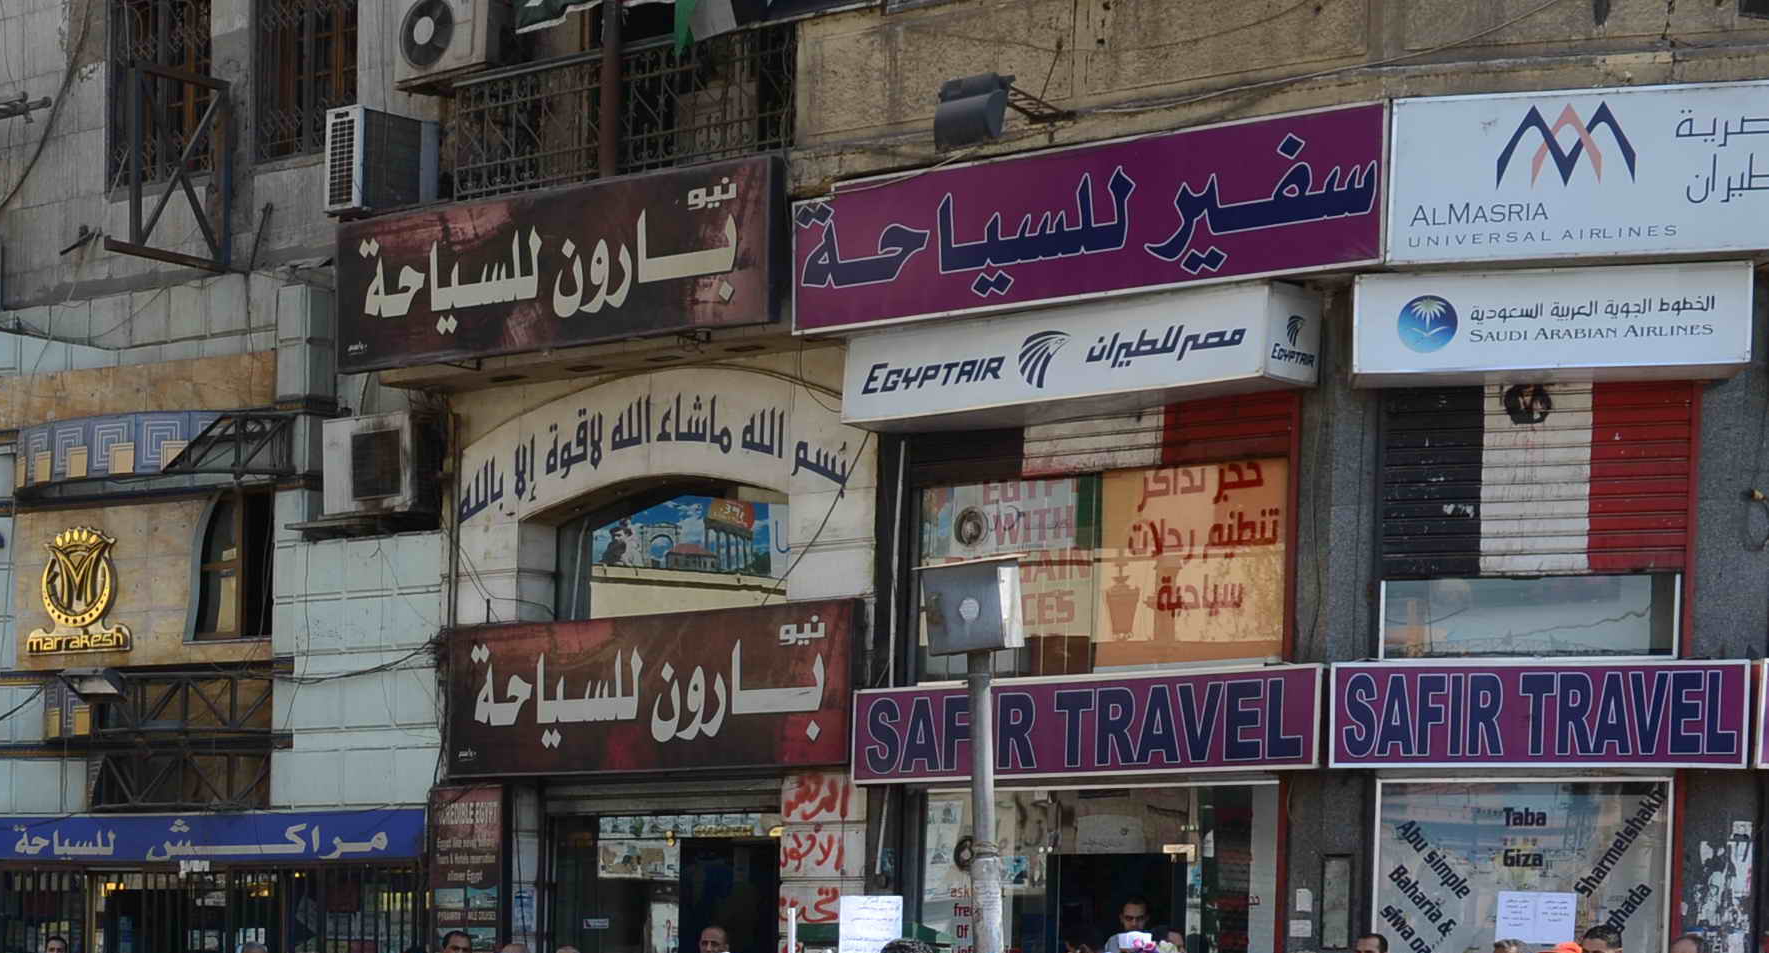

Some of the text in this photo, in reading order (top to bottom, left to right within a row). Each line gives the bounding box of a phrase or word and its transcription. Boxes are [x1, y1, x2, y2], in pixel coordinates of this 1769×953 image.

[1675, 109, 1769, 147] صرية
[687, 178, 737, 210] نيو
[1686, 152, 1769, 203] طيران
[796, 133, 1378, 296] سفير للسياحة
[1408, 224, 1678, 248] UNIVERSAL AIRLINES
[359, 209, 737, 335] بارون للسياحة
[1470, 295, 1715, 326] الخطوط الجوية العربية السعودية
[611, 394, 651, 452] الله
[741, 406, 785, 459] الله
[460, 456, 506, 524] بالله
[791, 440, 848, 498] بسم
[779, 614, 826, 647] نيو
[470, 638, 826, 750] بارون للسياحة
[1342, 670, 1737, 758] SAFIR TRAVEL
[865, 677, 1304, 775] SAFR TRAVEL
[14, 819, 388, 862] مراكش للسياحة
[1396, 820, 1430, 853] Abu
[1503, 807, 1547, 828] Taba
[1423, 848, 1471, 899] simple
[1503, 848, 1544, 868] Giza
[1388, 864, 1444, 924] Baharia
[1605, 881, 1652, 936] ghada
